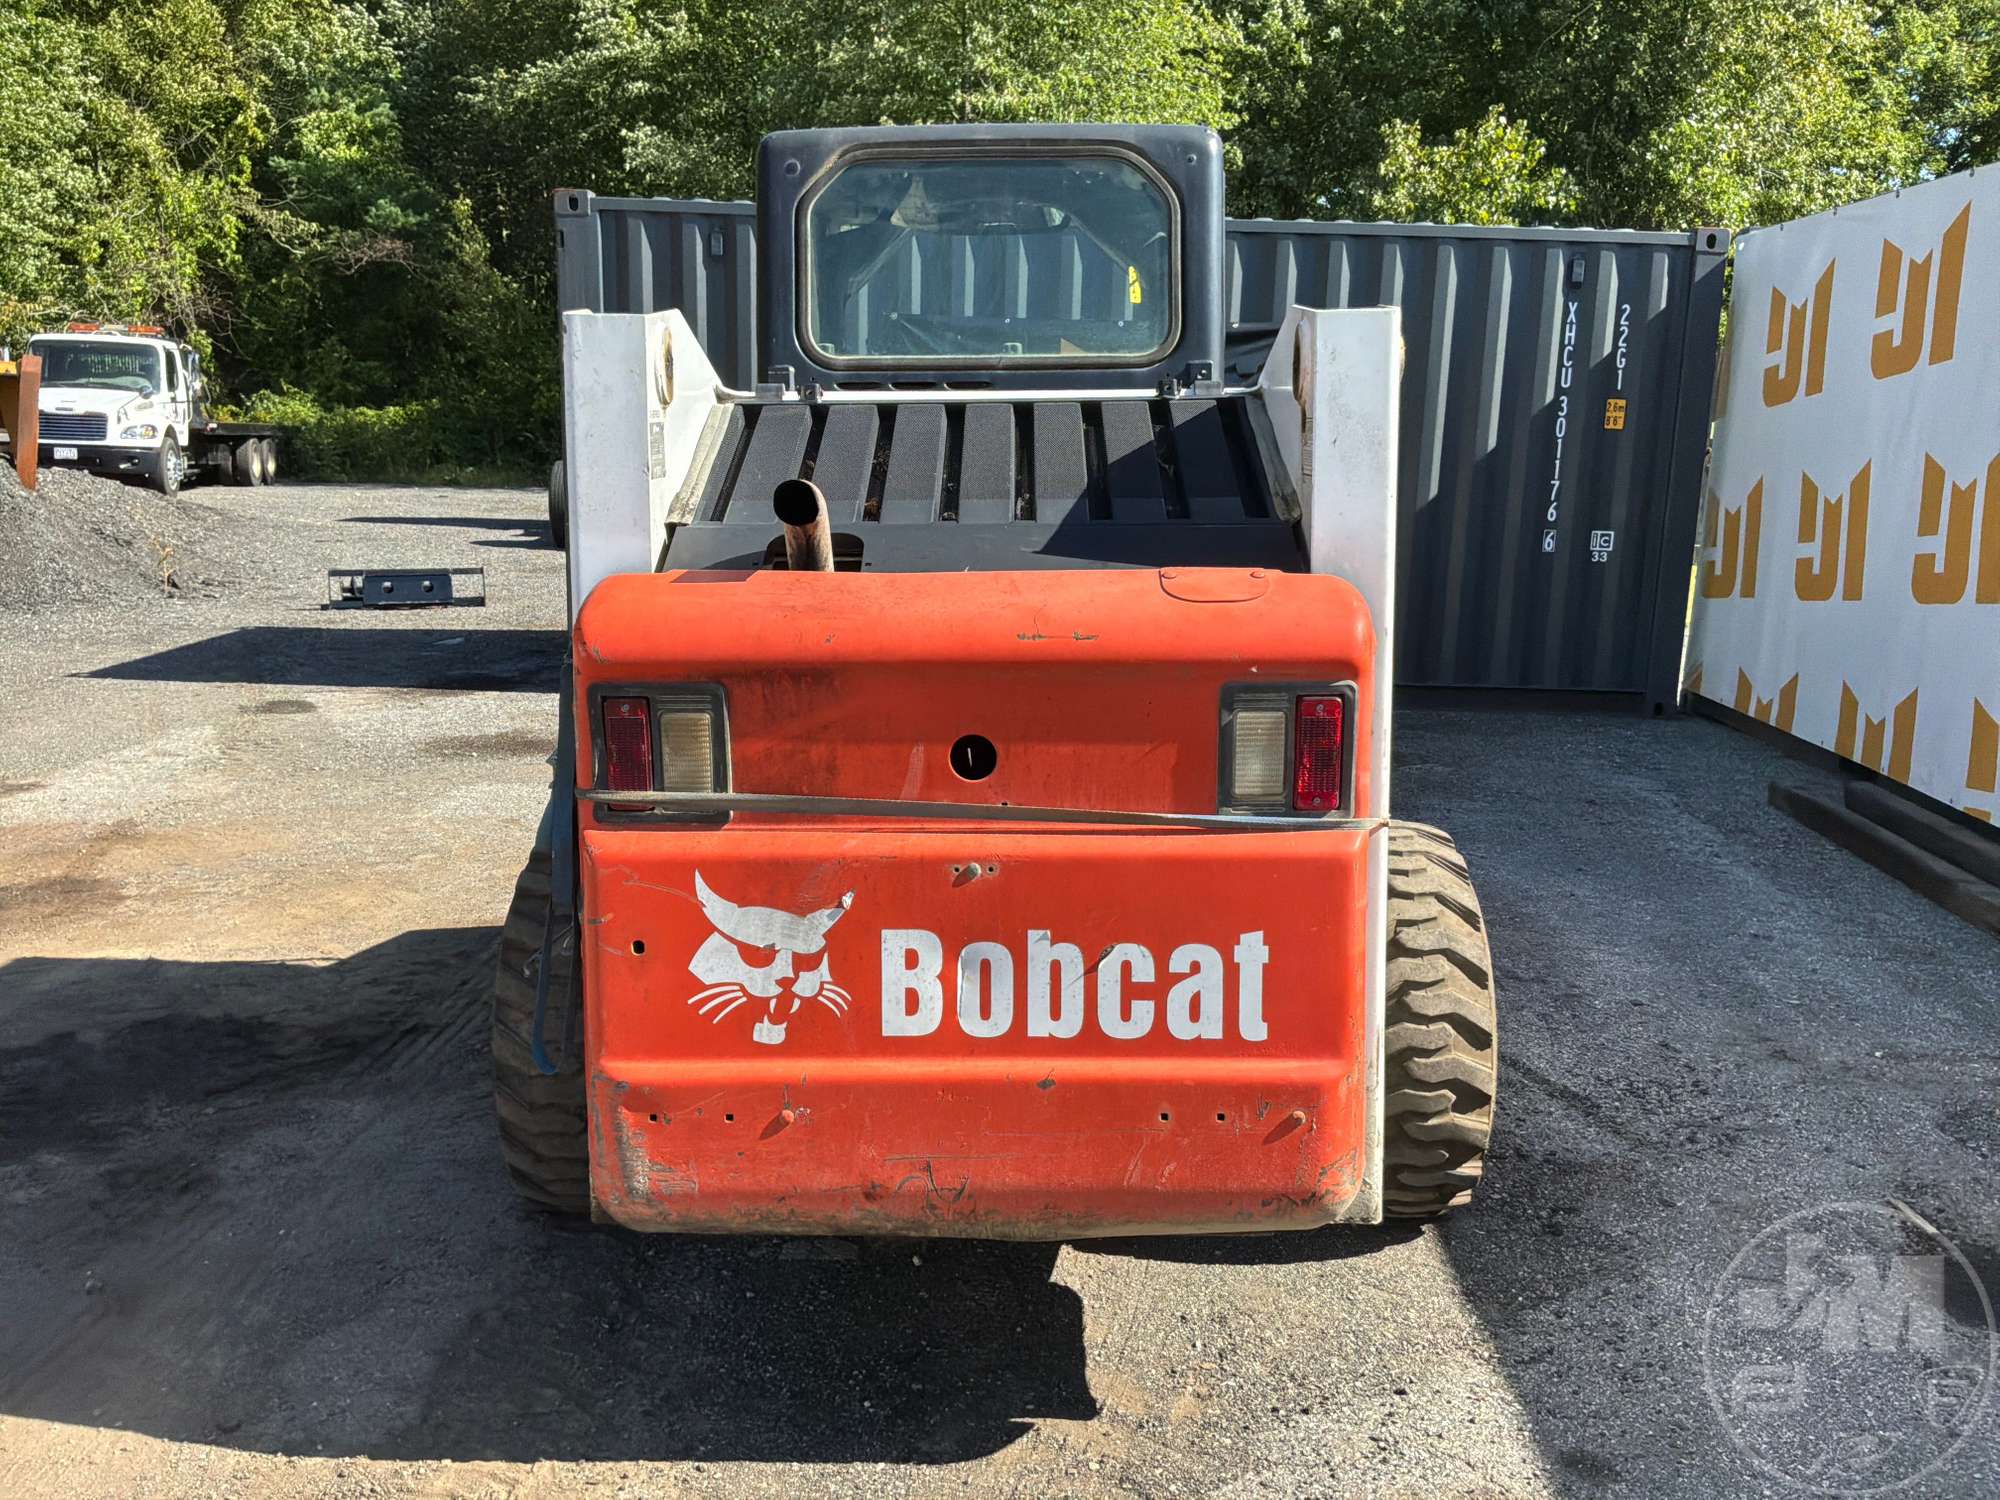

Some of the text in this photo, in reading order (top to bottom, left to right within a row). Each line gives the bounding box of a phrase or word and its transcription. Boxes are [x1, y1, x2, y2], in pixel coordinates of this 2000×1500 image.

[1616, 303, 1631, 390] 22G1
[1544, 301, 1578, 551] XHCU 301176 6
[1591, 551, 1608, 563] 33
[879, 928, 1271, 1042] Bobcat
